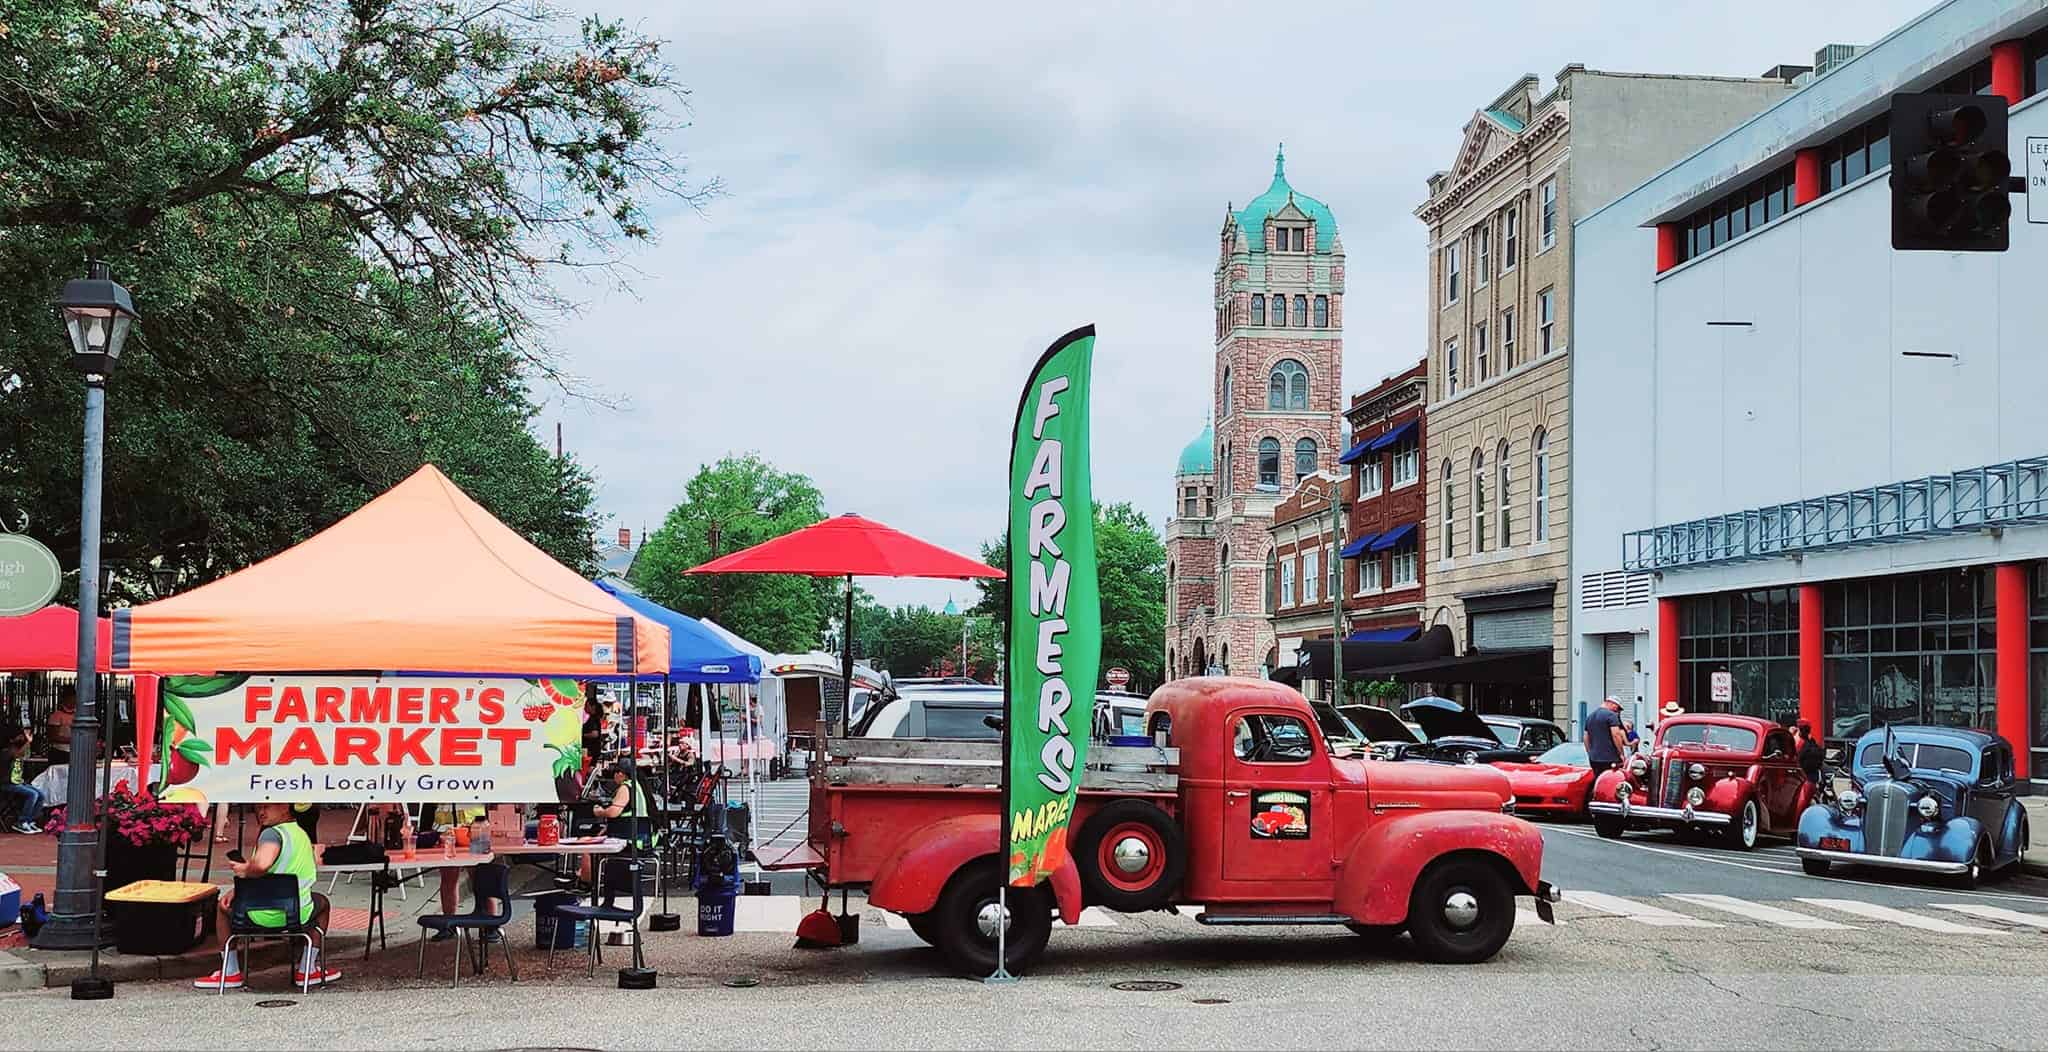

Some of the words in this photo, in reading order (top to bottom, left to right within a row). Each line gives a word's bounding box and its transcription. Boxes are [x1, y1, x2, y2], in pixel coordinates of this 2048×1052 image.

[2032, 176, 2047, 186] ON
[1023, 375, 1077, 794] FARMERS
[245, 686, 505, 724] FARMER'S
[215, 727, 532, 766] MARKET
[250, 774, 313, 790] Fresh
[325, 774, 407, 794] Locally
[418, 775, 495, 790] Grown
[700, 905, 711, 913] DO
[714, 905, 723, 913] IT
